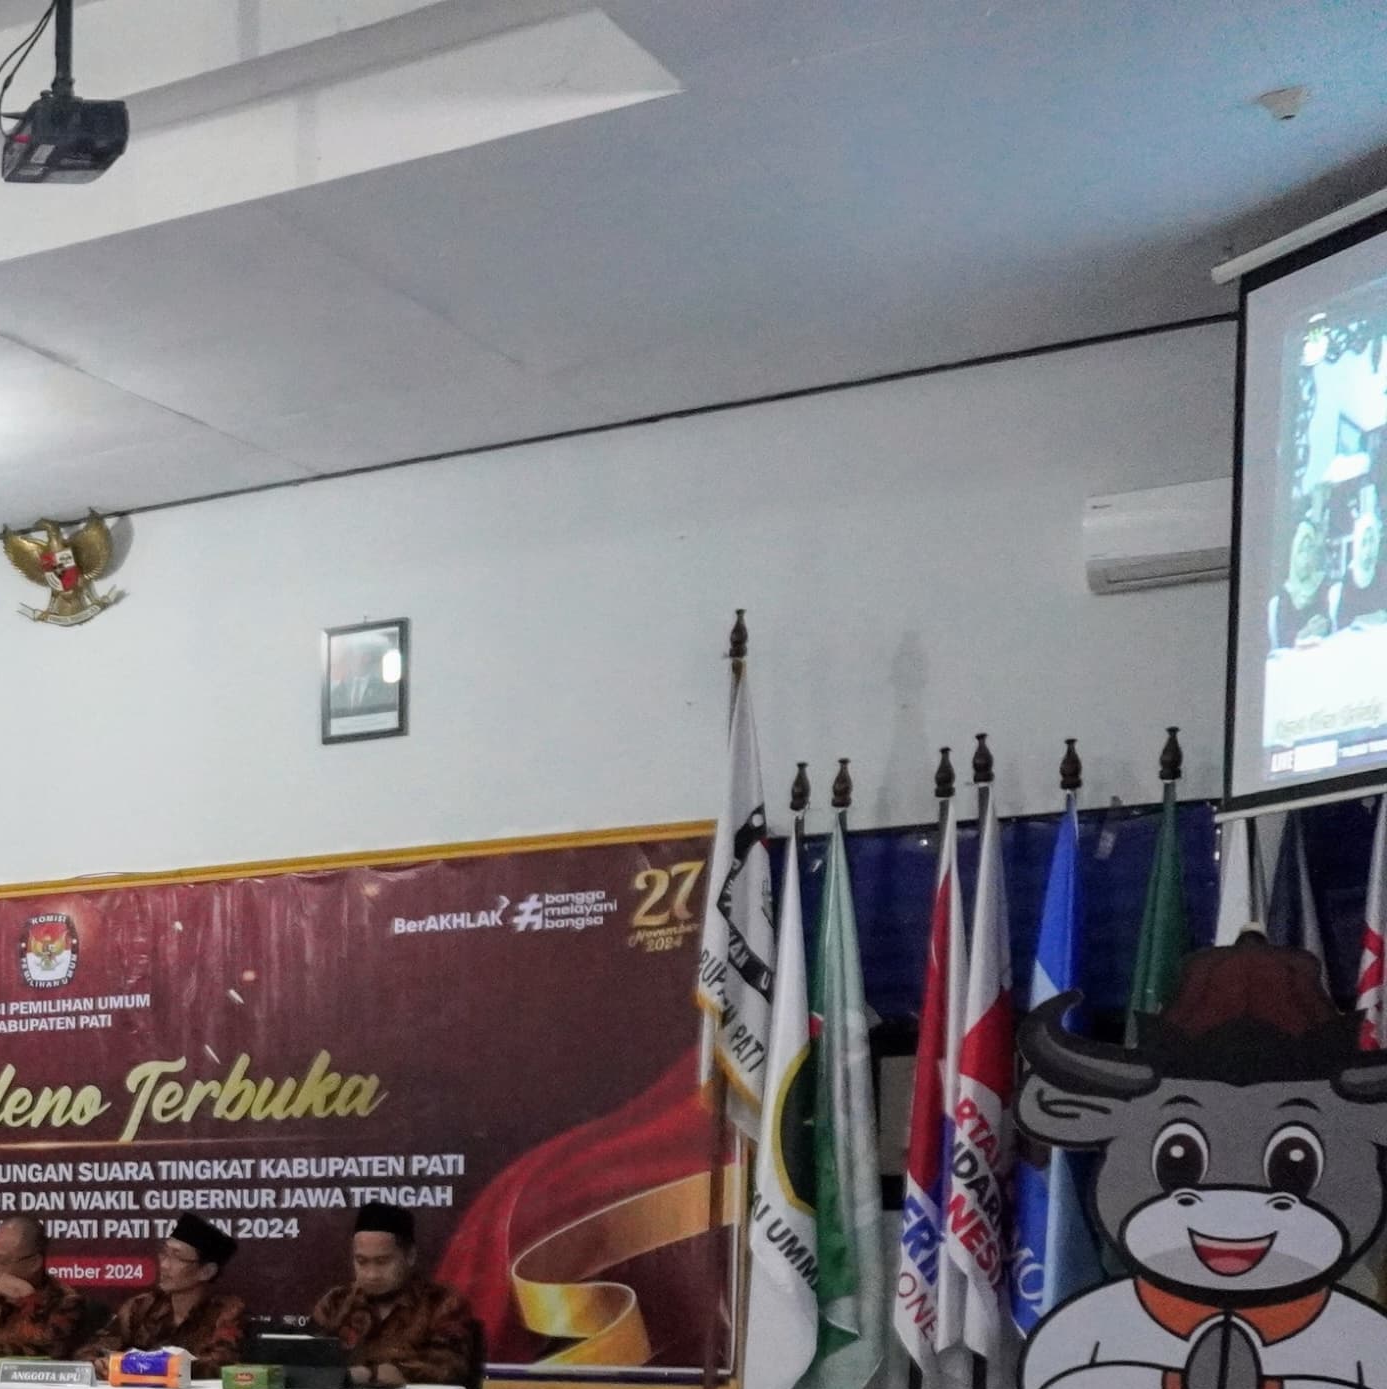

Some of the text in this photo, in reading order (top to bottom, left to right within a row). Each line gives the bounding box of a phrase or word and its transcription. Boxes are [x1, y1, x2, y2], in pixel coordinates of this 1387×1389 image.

[545, 890, 606, 904] bangga
[633, 861, 706, 926] 27
[544, 900, 618, 917] melayani
[31, 914, 67, 925] KOMISI
[393, 907, 503, 934] BerAKHLAK
[545, 916, 604, 930] bangsa
[628, 923, 701, 948] November
[9, 997, 94, 1015] PEMILIHAN
[98, 994, 151, 1009] UMUM
[79, 1014, 112, 1028] PATI
[120, 1050, 389, 1143] Terbuka
[78, 1161, 154, 1183] SUARA
[158, 1159, 256, 1180] TINGKAT
[260, 1156, 407, 1178] KABUPATEN
[411, 1154, 465, 1176] PATI
[20, 1191, 65, 1211] DAN
[69, 1190, 139, 1211] WAKIL
[144, 1188, 276, 1210] GUBERNUR
[280, 1187, 346, 1208] JAWA
[350, 1185, 453, 1207] TENGAH
[45, 1217, 98, 1239] UPATI
[104, 1218, 150, 1238] PATI
[155, 1217, 232, 1238] TAN
[237, 1216, 300, 1238] 2024
[104, 1261, 144, 1280] 2024
[11, 1371, 56, 1382] ANGGOTA
